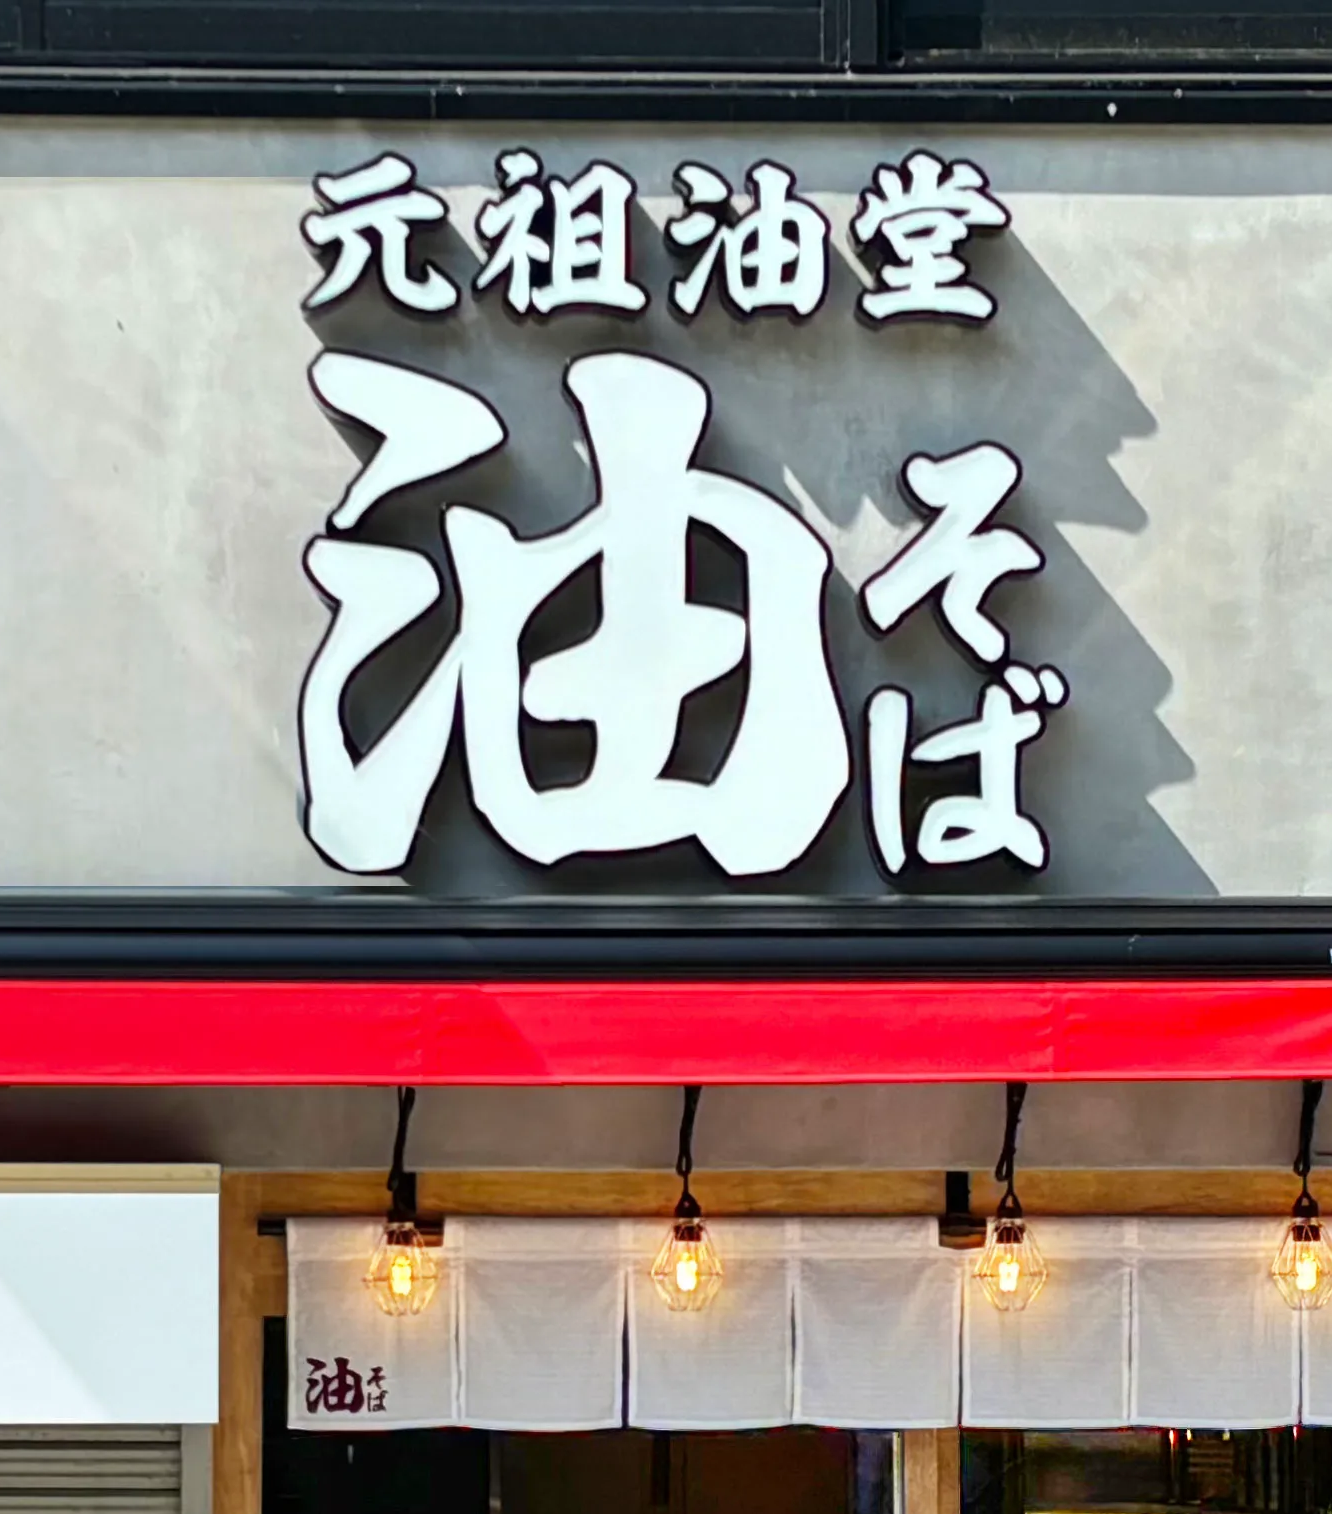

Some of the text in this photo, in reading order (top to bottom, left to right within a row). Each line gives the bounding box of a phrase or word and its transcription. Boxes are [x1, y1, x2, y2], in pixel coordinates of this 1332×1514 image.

[300, 148, 1012, 327] 元祖油堂
[299, 350, 1069, 876] 油そば
[305, 1357, 389, 1414] 油そば
